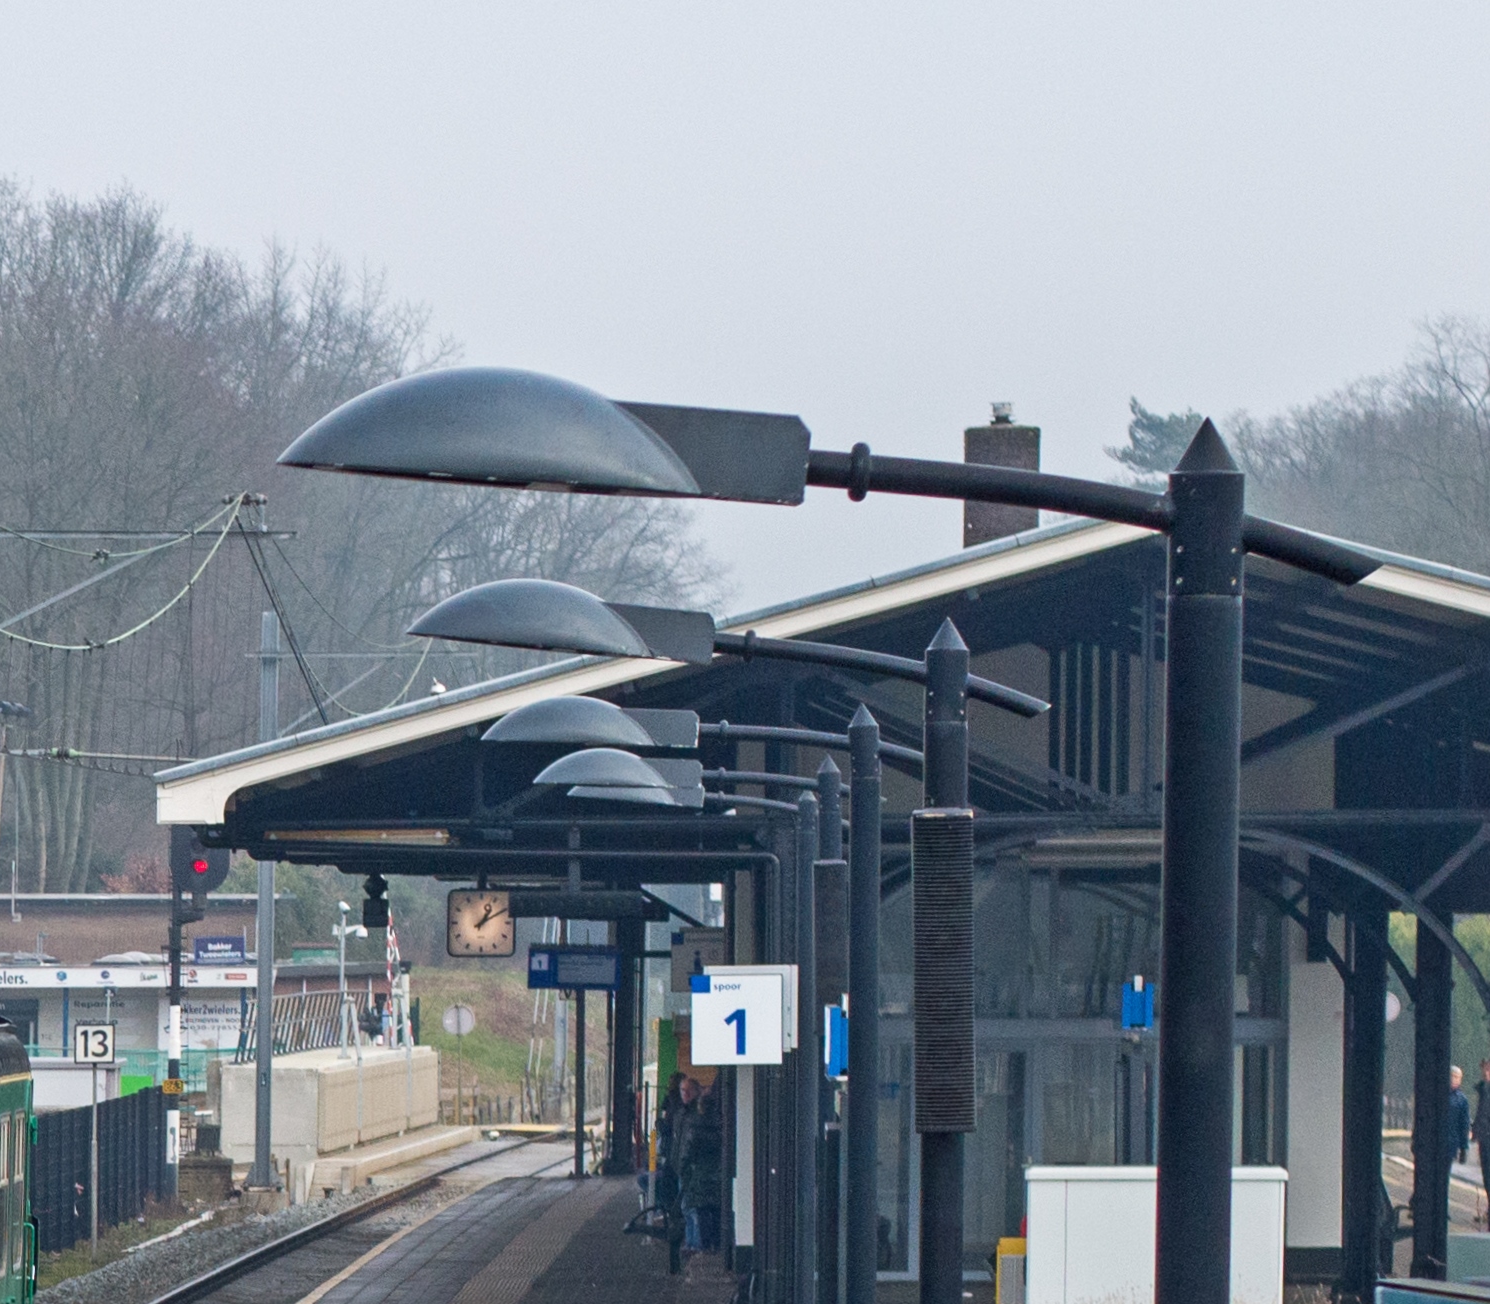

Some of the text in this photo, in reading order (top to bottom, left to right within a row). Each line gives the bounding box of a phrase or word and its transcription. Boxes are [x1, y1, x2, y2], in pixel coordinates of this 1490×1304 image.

[713, 982, 742, 993] spoor
[80, 1029, 109, 1058] 13
[723, 1008, 746, 1056] 1
